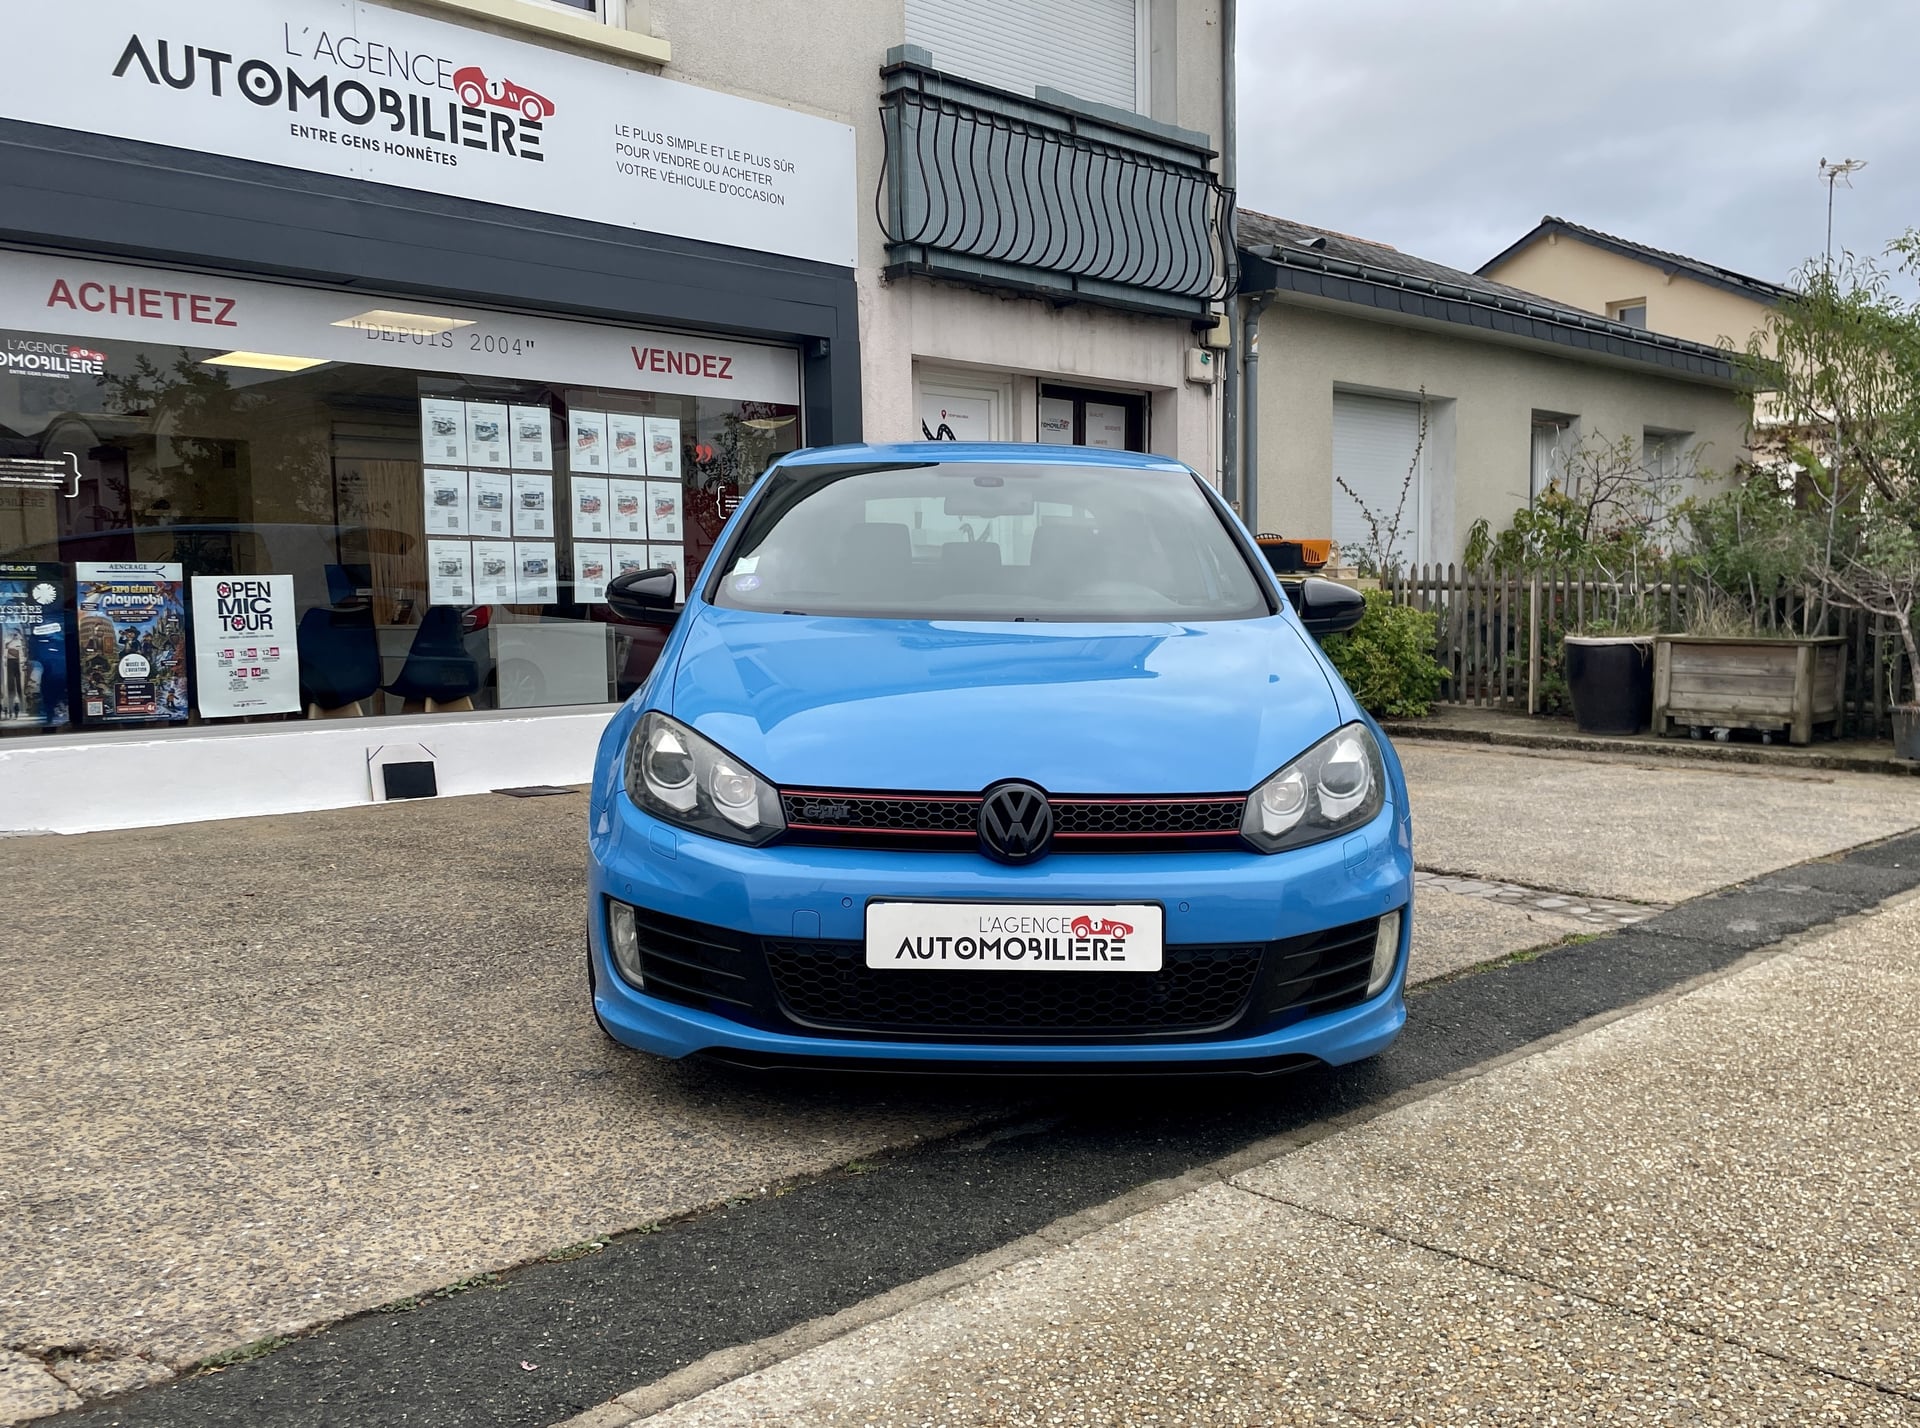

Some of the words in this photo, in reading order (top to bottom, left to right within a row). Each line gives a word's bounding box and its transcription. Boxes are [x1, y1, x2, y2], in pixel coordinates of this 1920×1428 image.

[285, 22, 453, 91] L'AGENCE
[291, 124, 337, 144] ENTRE
[341, 133, 380, 151] GENS
[384, 142, 458, 166] HONNÊTES
[615, 123, 630, 138] LE
[633, 127, 664, 146] PLUS
[666, 135, 708, 155] SIMPLE
[710, 145, 725, 158] ET
[727, 148, 741, 162] LE
[743, 152, 770, 168] PLUS
[773, 158, 795, 174] SÛR
[616, 142, 650, 161] POUR
[653, 150, 701, 171] VENDRE
[703, 161, 720, 175] OU
[722, 165, 773, 186] ACHETER
[616, 161, 657, 180] VOTRE
[660, 169, 717, 193] VÉHICULE
[719, 181, 785, 206] D'OCCASION
[47, 278, 238, 327] ACHETEZ
[7, 339, 68, 356] L'AGENCE
[470, 333, 535, 356] 2004"
[631, 346, 733, 380] VENDEZ
[102, 593, 164, 608] playmobil
[112, 586, 130, 594] EXPO
[131, 584, 157, 594] GÉANTE
[216, 581, 271, 598] OPEN
[217, 597, 272, 615] MIC
[218, 614, 273, 631] TOUR
[802, 804, 852, 820] GTI
[979, 916, 1072, 934] L'AGENCE
[895, 936, 1126, 962] AUTOMOBILIERE
